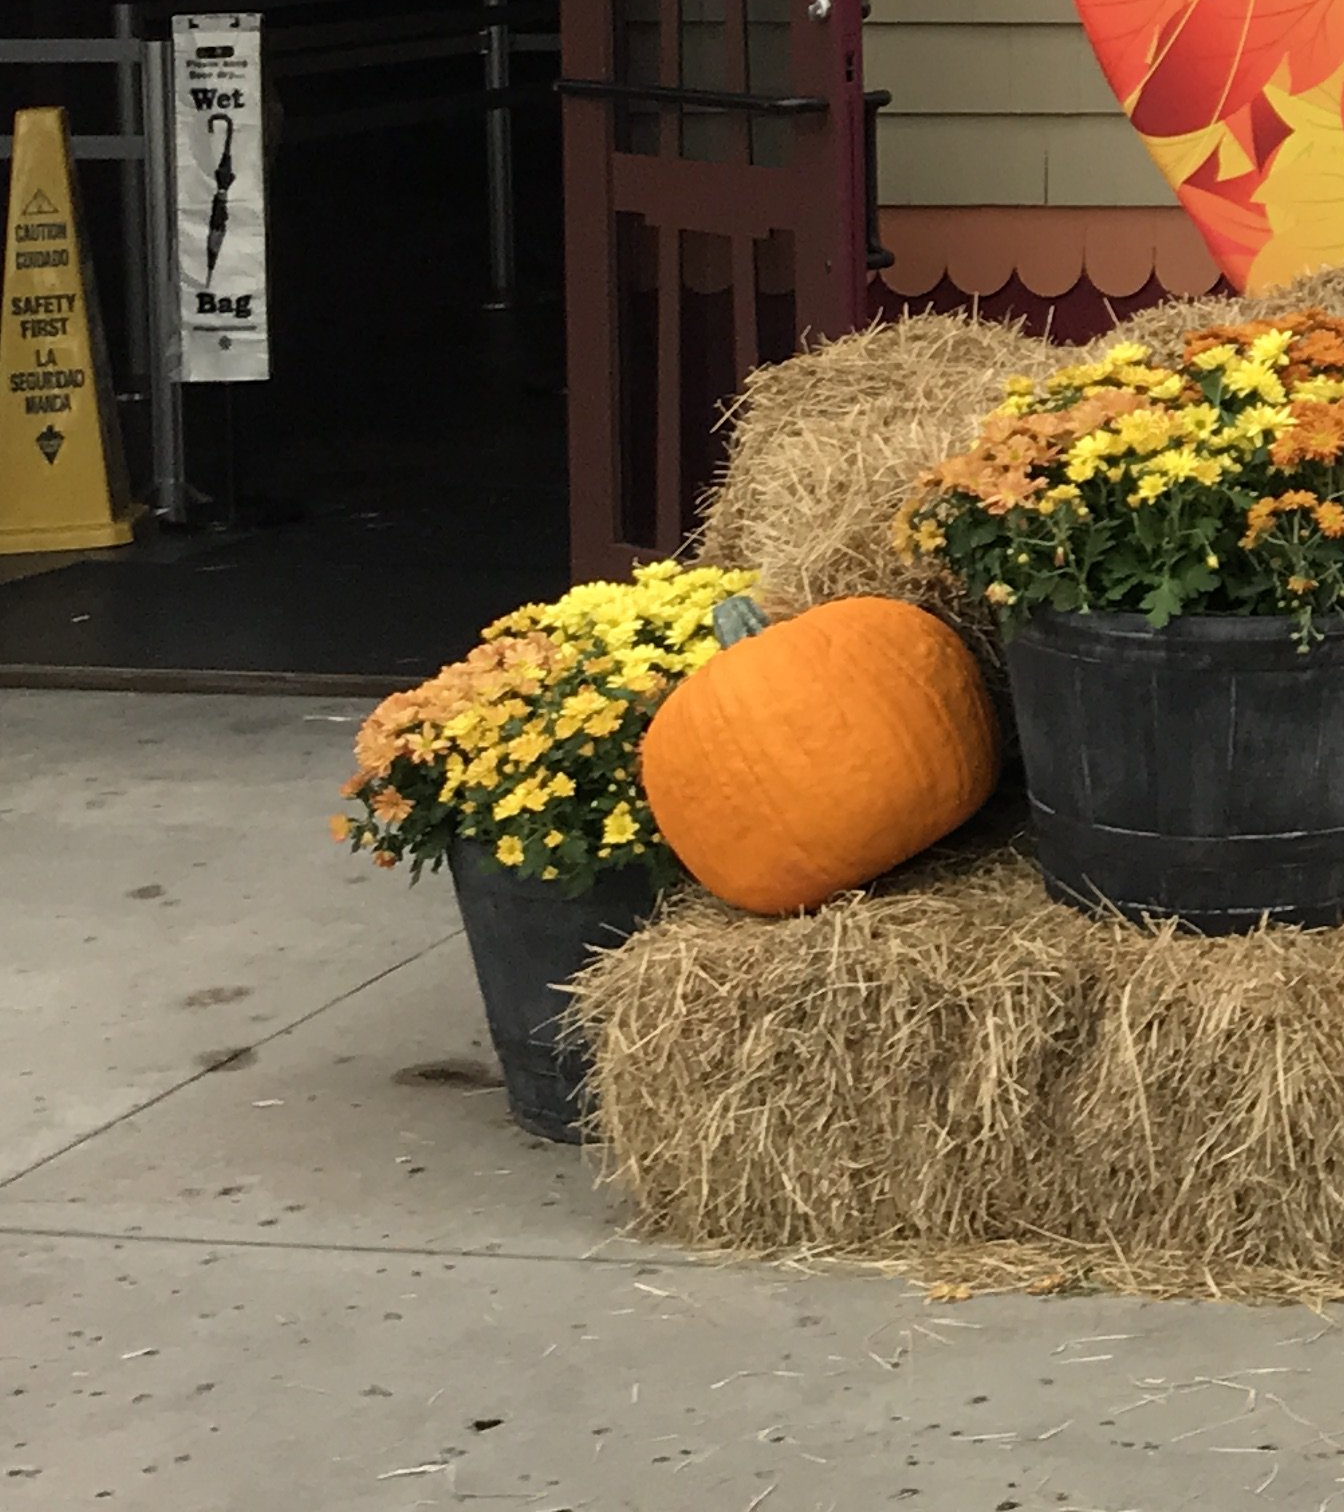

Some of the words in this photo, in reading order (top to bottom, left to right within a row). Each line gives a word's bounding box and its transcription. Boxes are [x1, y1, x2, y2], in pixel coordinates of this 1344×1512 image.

[190, 88, 245, 111] Wet
[15, 223, 67, 243] CAUTION
[11, 293, 76, 316] SAFETY
[195, 292, 252, 319] Bag
[20, 317, 70, 339] FIRST
[35, 348, 58, 367] LA
